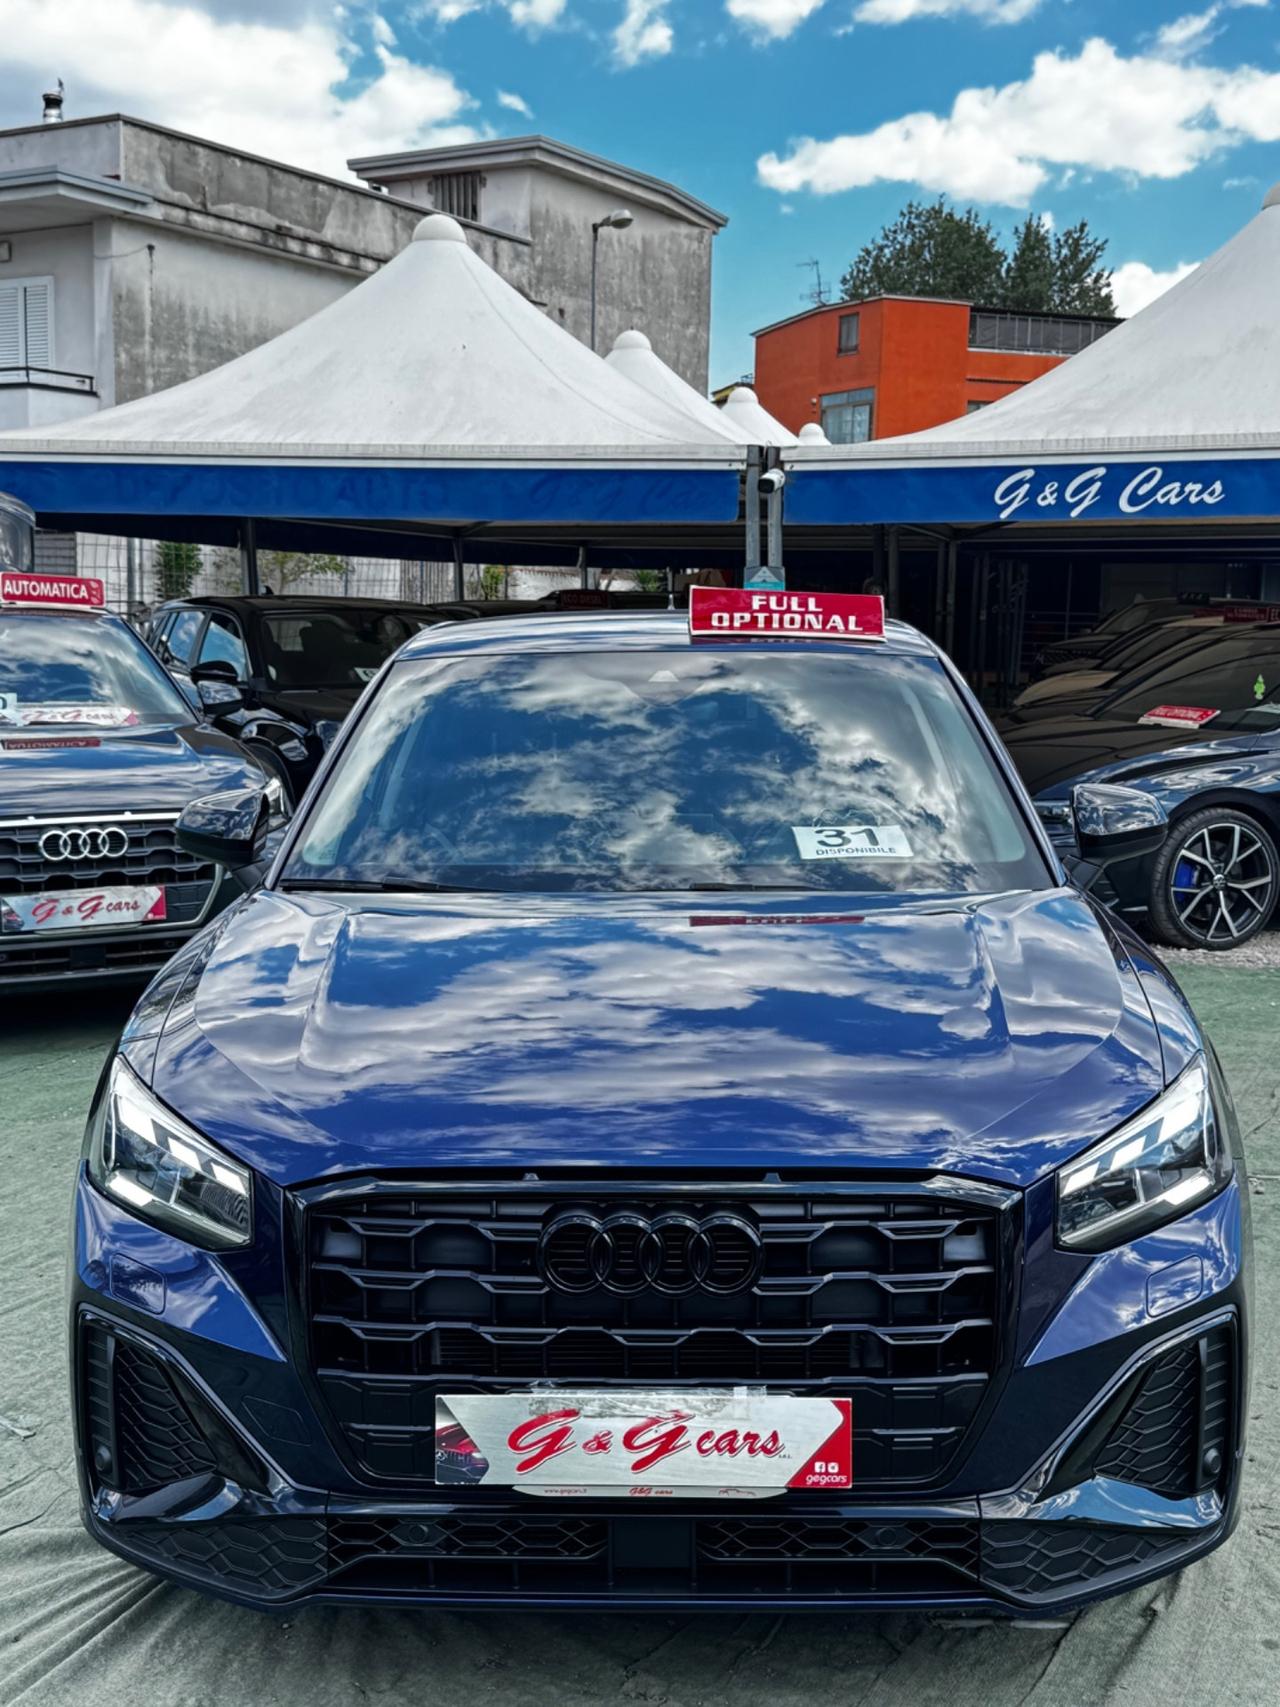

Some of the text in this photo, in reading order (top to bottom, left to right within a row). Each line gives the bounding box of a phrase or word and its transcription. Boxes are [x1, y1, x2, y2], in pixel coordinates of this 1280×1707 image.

[1119, 466, 1226, 513] Cars
[3, 579, 89, 599] AUTOMATICA
[751, 595, 823, 612] FULL
[711, 612, 863, 631] OPTIONAL
[815, 828, 879, 847] 31
[816, 847, 896, 856] DISPONIBILE
[106, 898, 140, 912] cars
[696, 1429, 785, 1458] cars
[806, 1474, 849, 1485] gegcars
